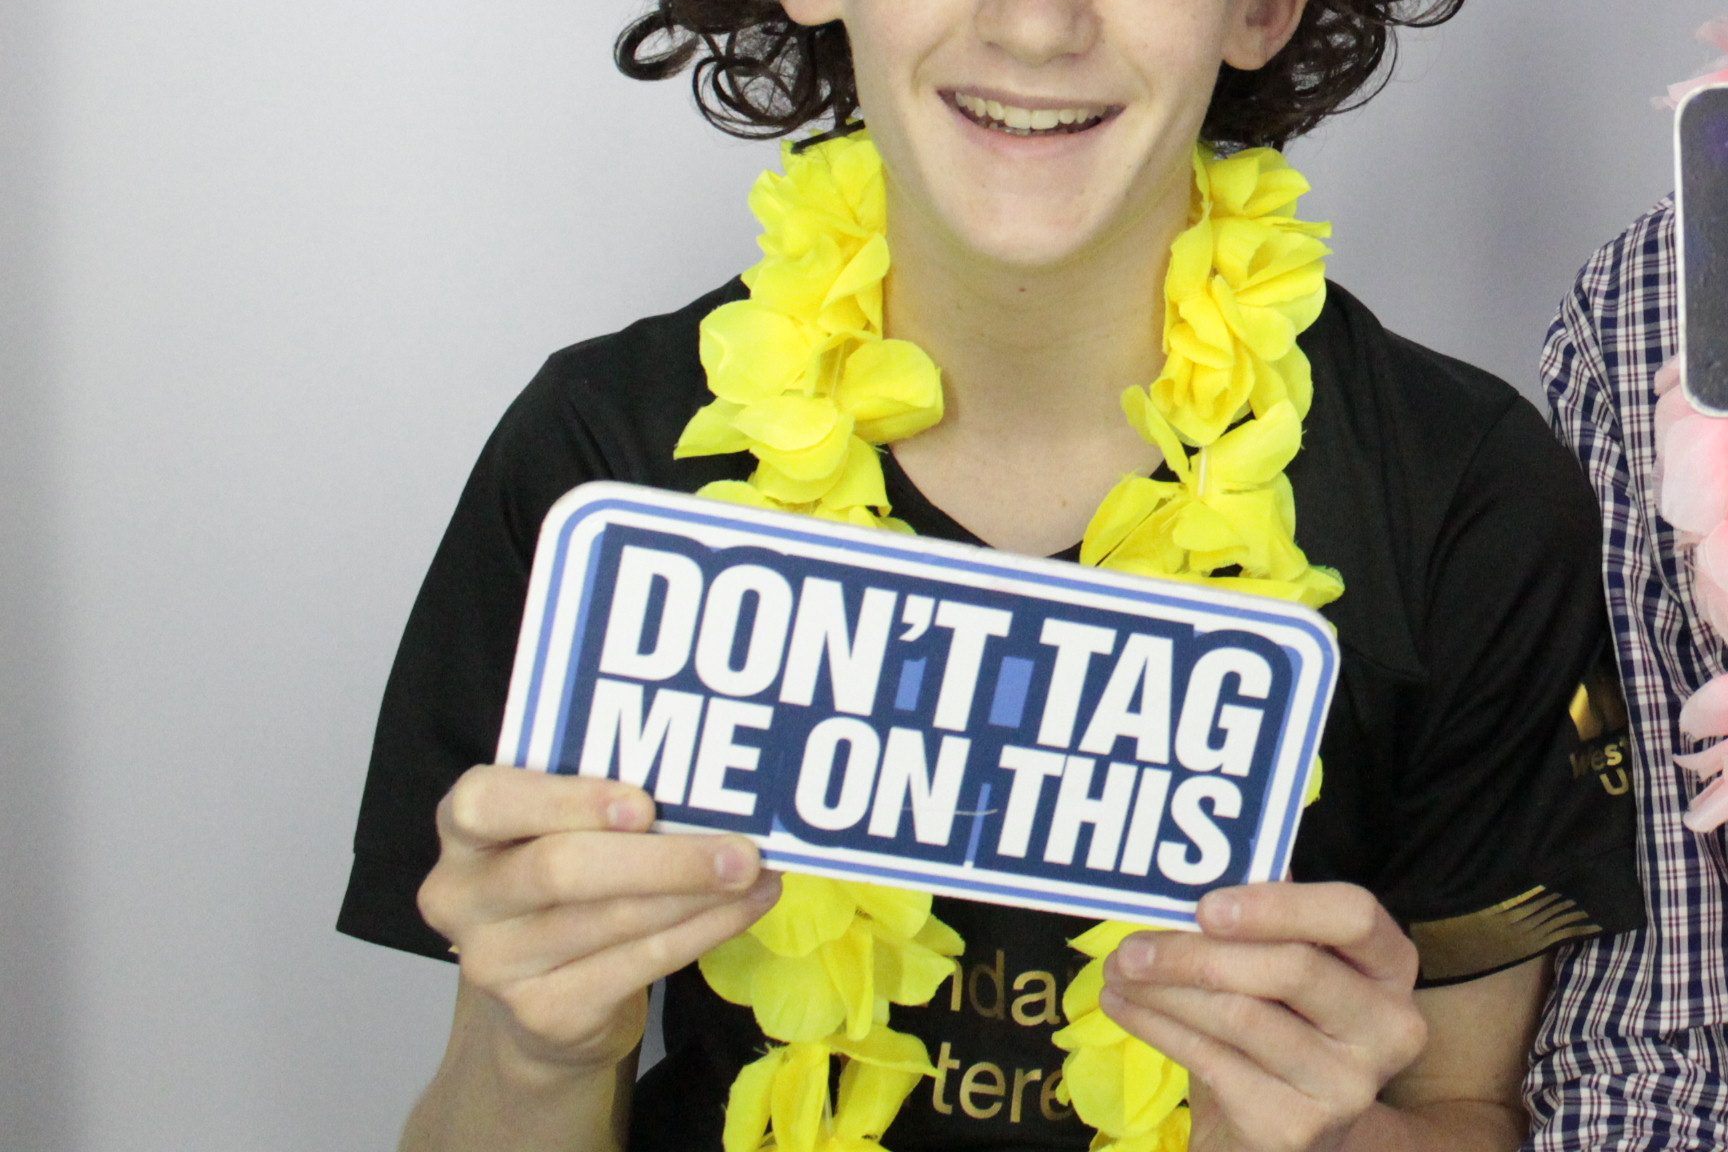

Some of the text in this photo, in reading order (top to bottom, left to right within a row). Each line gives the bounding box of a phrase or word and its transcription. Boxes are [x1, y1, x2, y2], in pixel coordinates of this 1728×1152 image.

[598, 544, 1273, 778] DON'T TAG
[578, 677, 1243, 886] ME ON THIS
